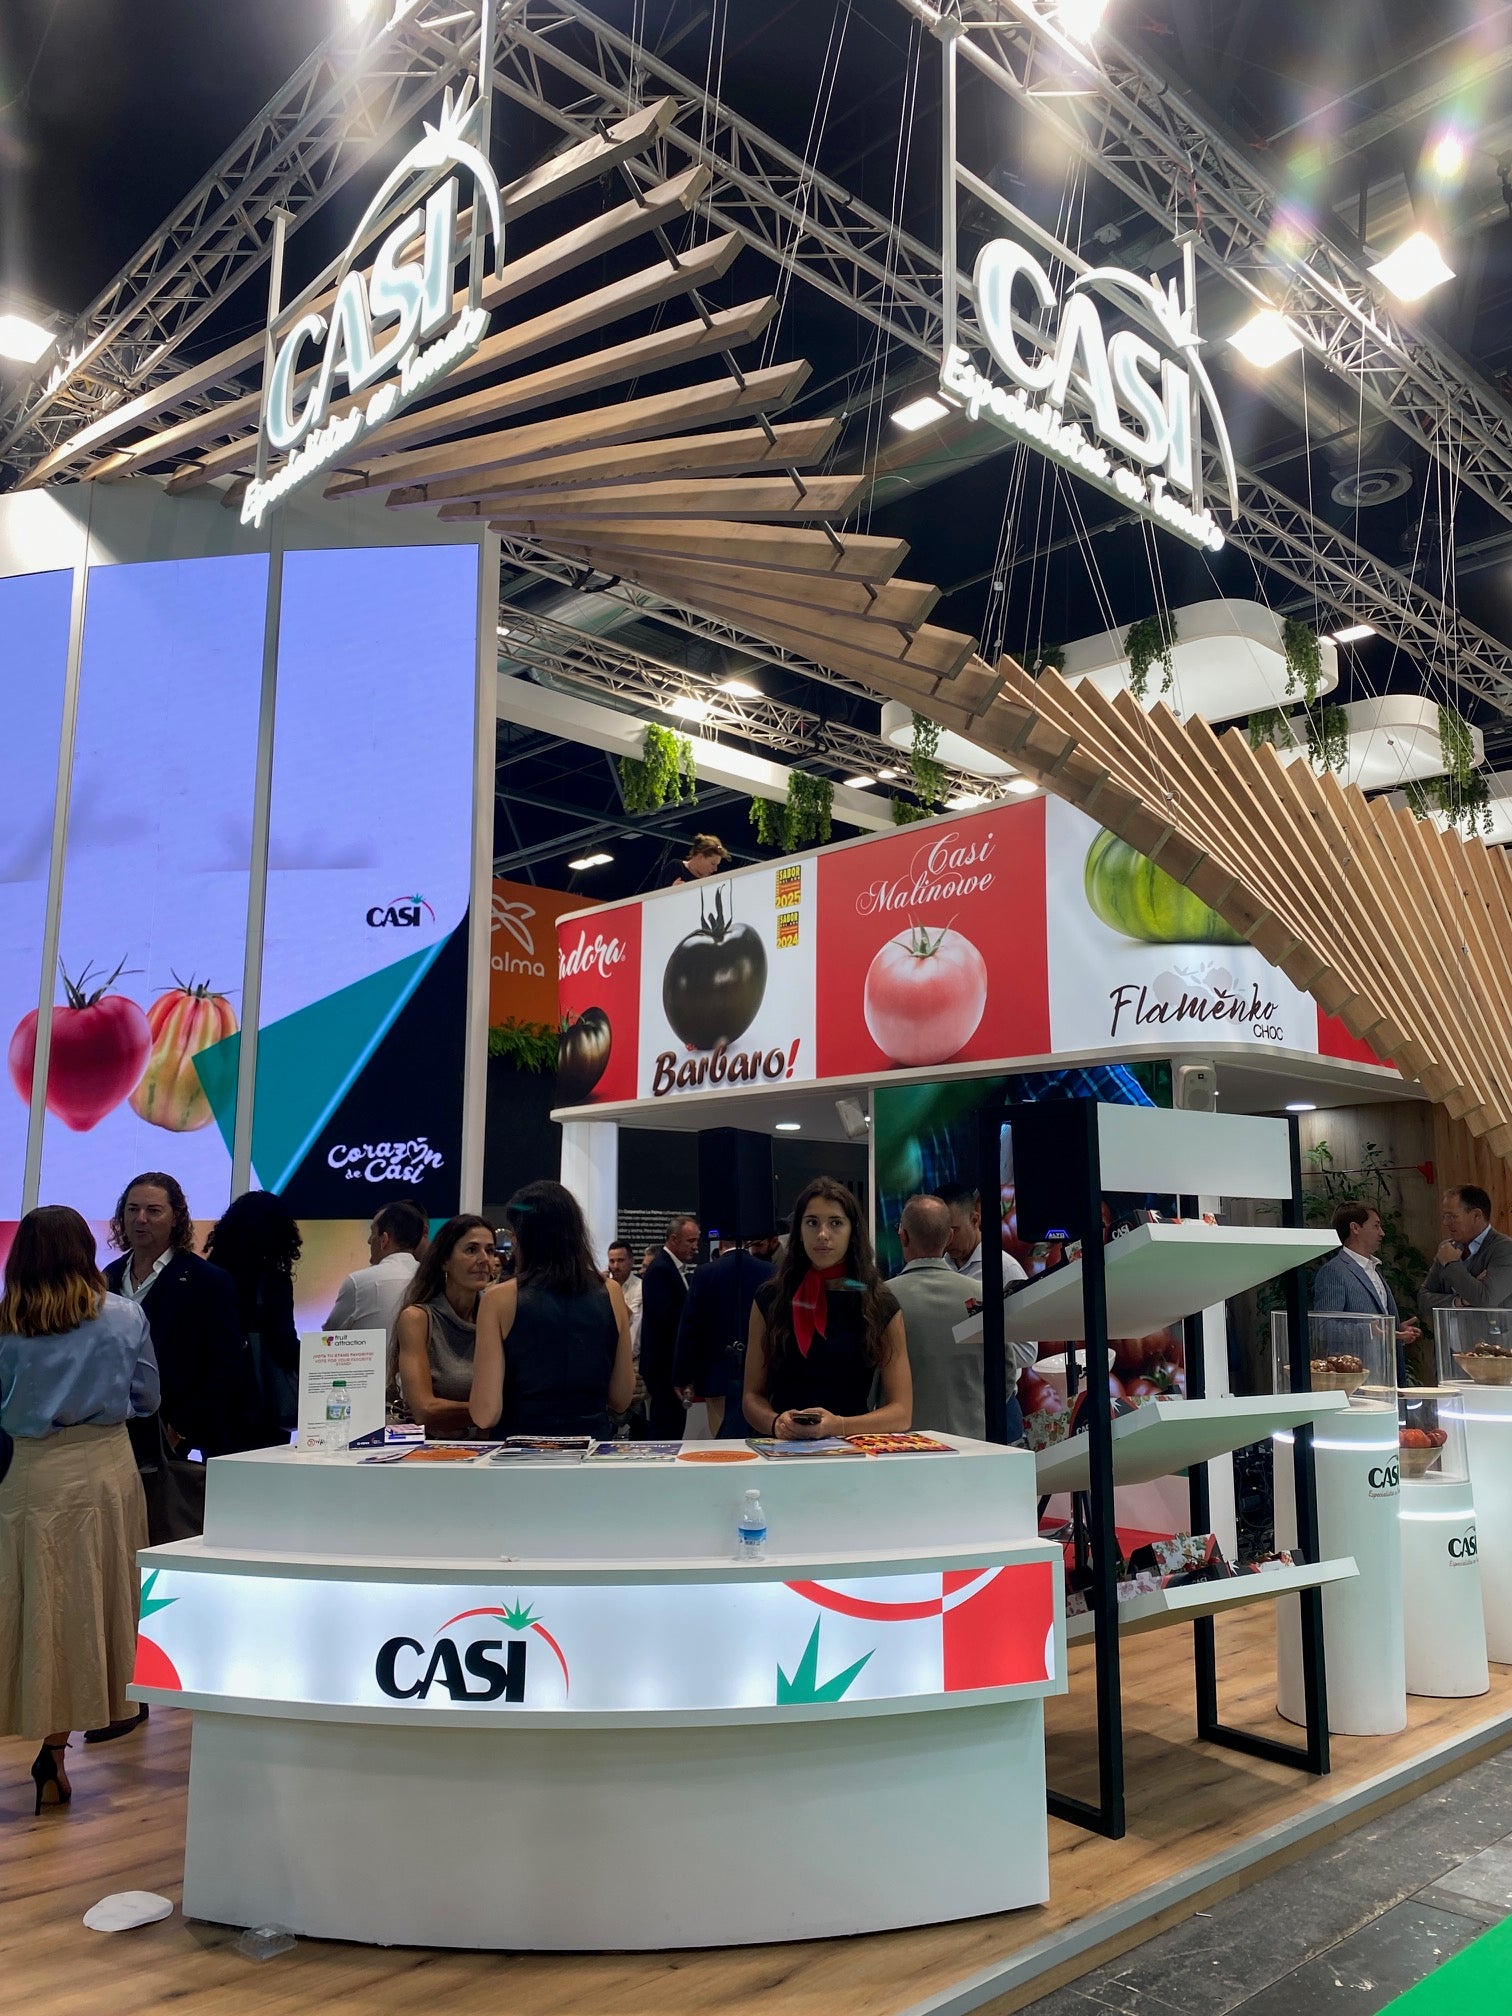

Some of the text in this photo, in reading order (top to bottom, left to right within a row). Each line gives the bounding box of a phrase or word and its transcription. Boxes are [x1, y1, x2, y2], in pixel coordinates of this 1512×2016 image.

[266, 177, 458, 451] CASI
[973, 238, 1193, 494] CASI
[912, 831, 996, 876] Casi
[779, 865, 801, 880] SABOR
[776, 890, 801, 909] 2025
[856, 870, 996, 916] Malinowe
[366, 906, 421, 928] CASI
[777, 933, 798, 949] 2024
[1253, 1023, 1284, 1041] CHOC
[653, 1038, 801, 1097] Barbaro!
[364, 1158, 425, 1184] Casi
[375, 1636, 527, 1703] CASI
